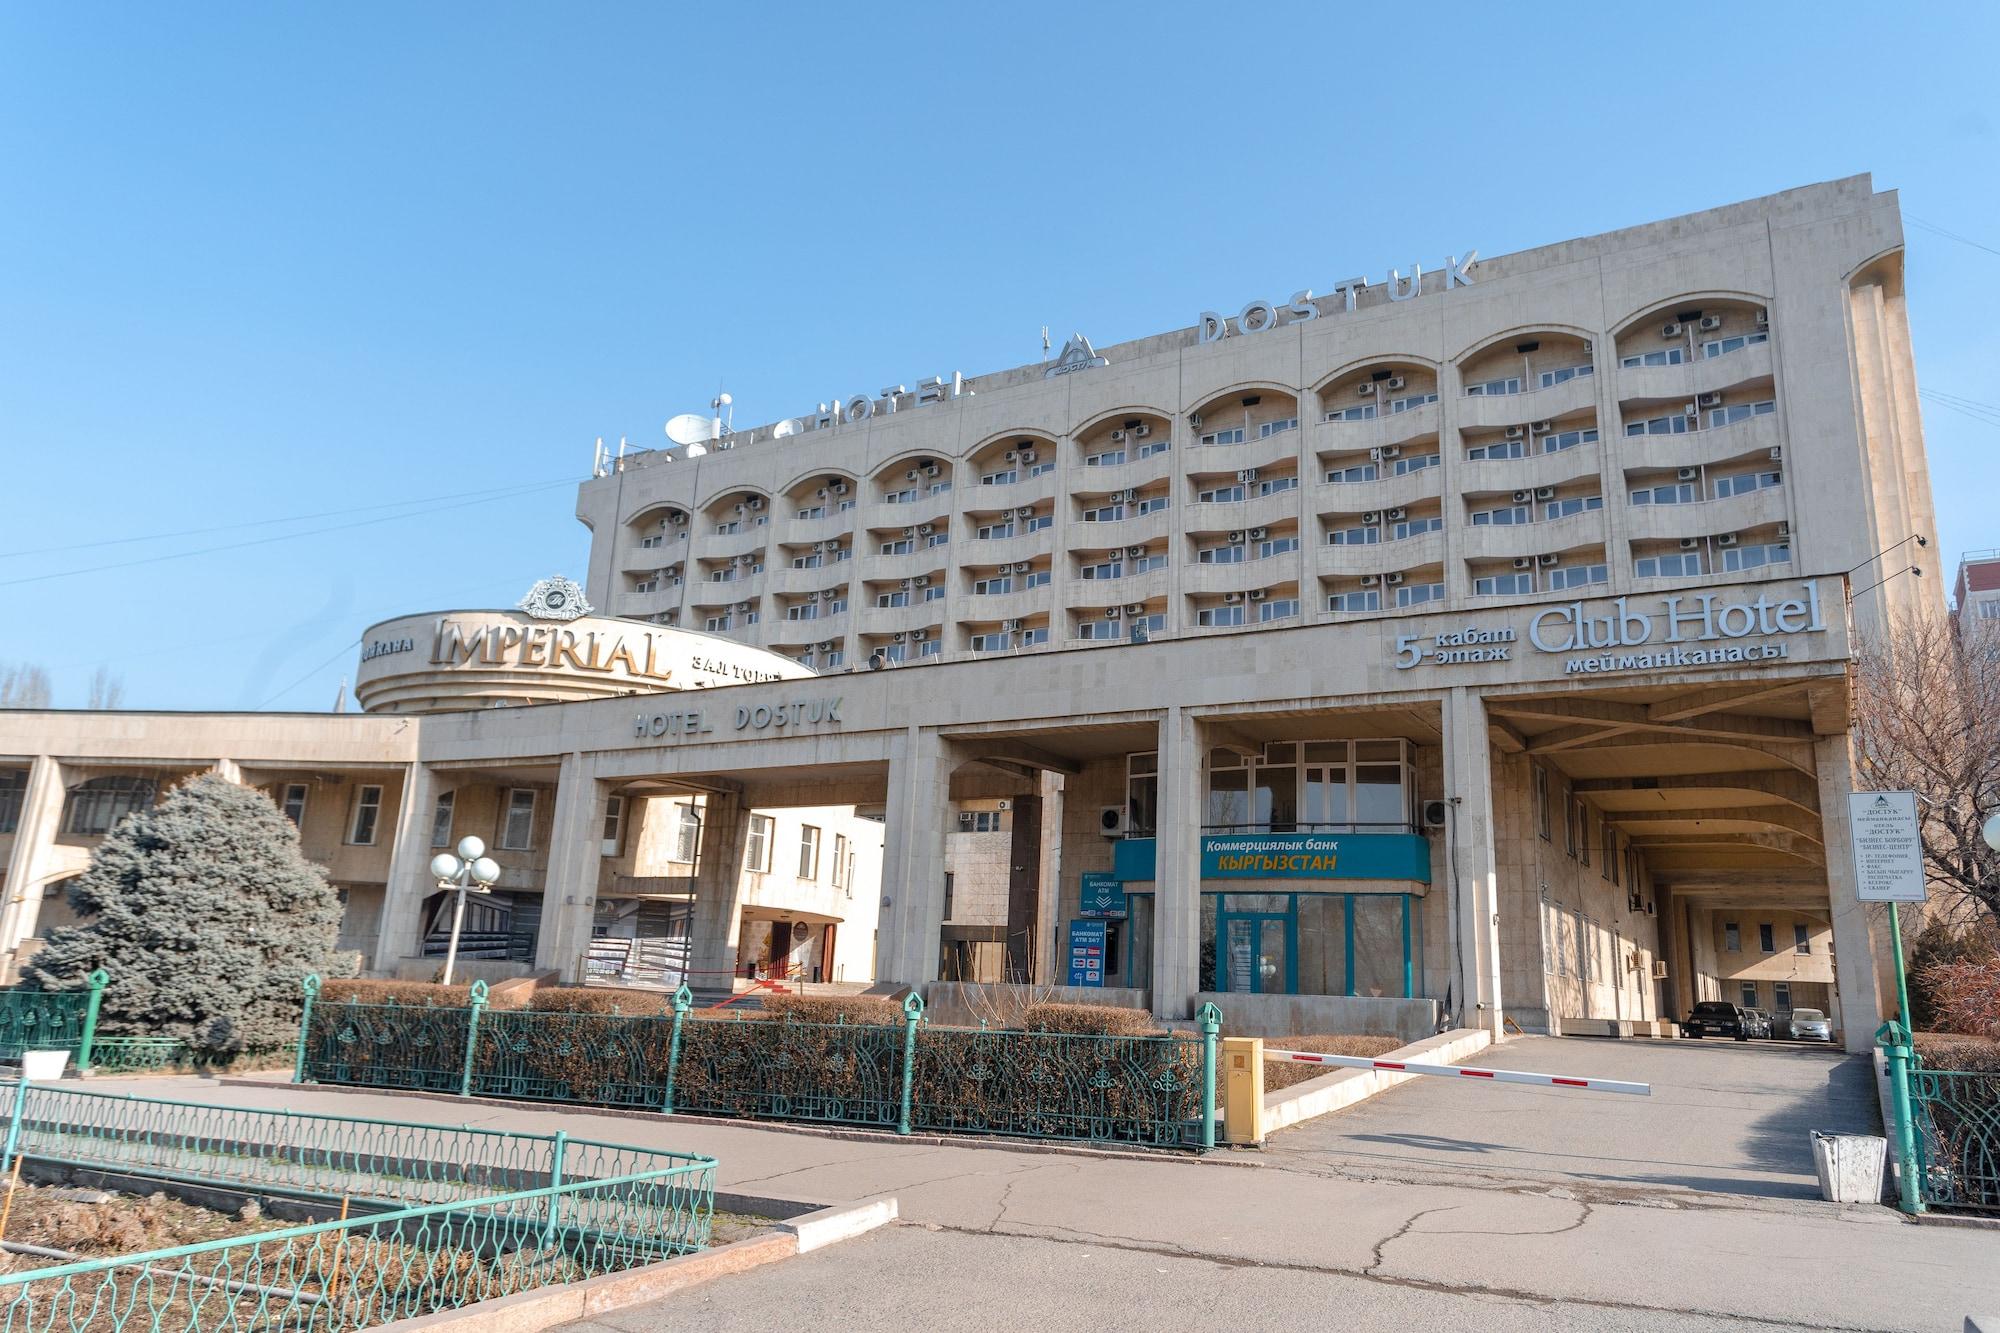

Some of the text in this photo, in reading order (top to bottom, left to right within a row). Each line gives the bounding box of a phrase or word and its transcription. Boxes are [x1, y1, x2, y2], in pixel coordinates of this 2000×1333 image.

[815, 250, 1478, 429] HOTEL DOSTUK
[1529, 579, 1826, 652] Club Hotel
[428, 617, 673, 681] IMPERIAL
[1434, 623, 1518, 648] кабат
[1434, 646, 1512, 666] этаж
[1564, 643, 1788, 674] мейманканасы
[633, 697, 843, 738] HOTEL DOSTUK
[1206, 838, 1339, 853] Коммерциялык банк
[1217, 855, 1337, 871] КЫРГЫЗСТАН
